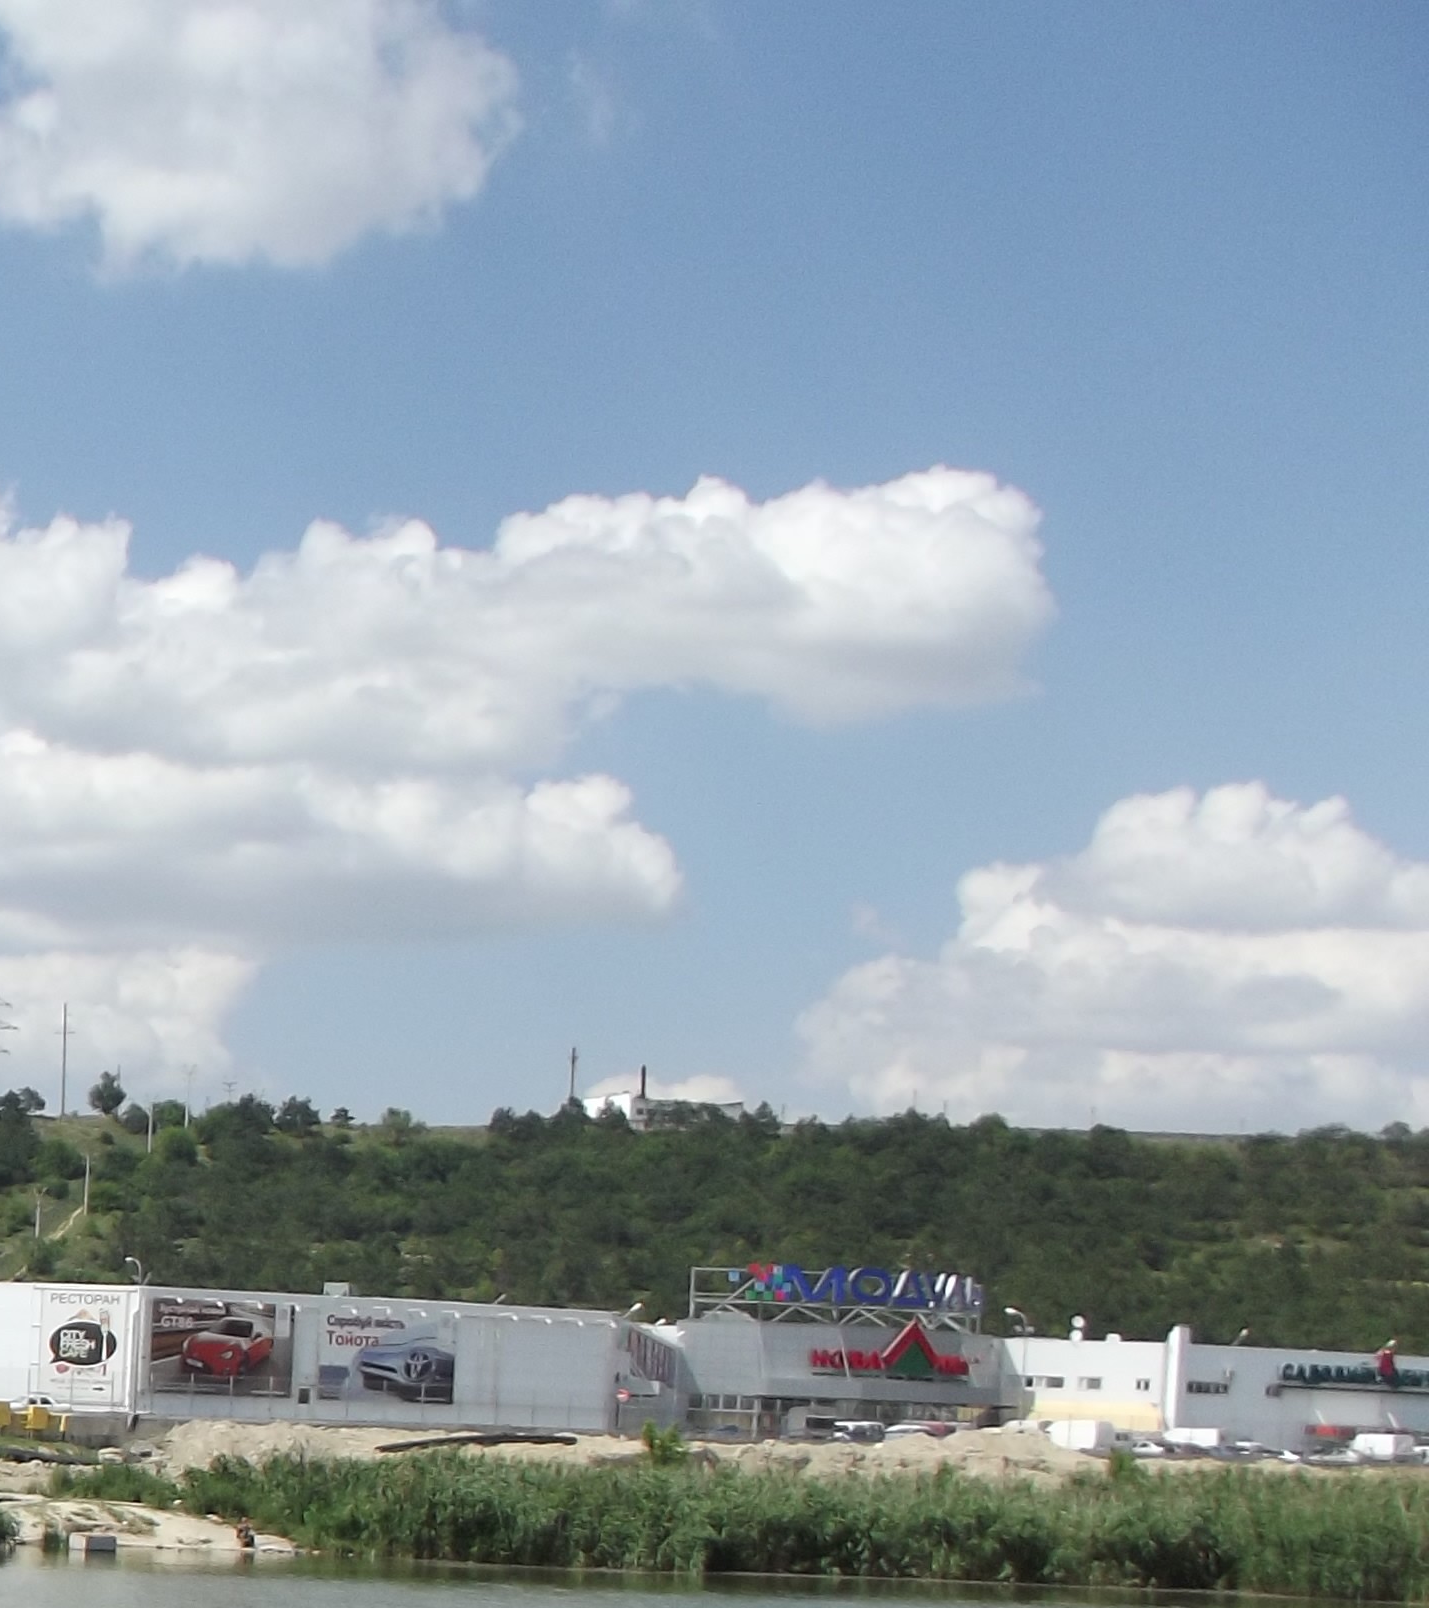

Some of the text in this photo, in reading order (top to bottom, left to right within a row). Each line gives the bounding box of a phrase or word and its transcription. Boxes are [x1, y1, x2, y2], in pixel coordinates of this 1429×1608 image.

[50, 1293, 120, 1305] РЕСТОРАН
[60, 1329, 87, 1340] CITY
[326, 1330, 380, 1347] Тойота
